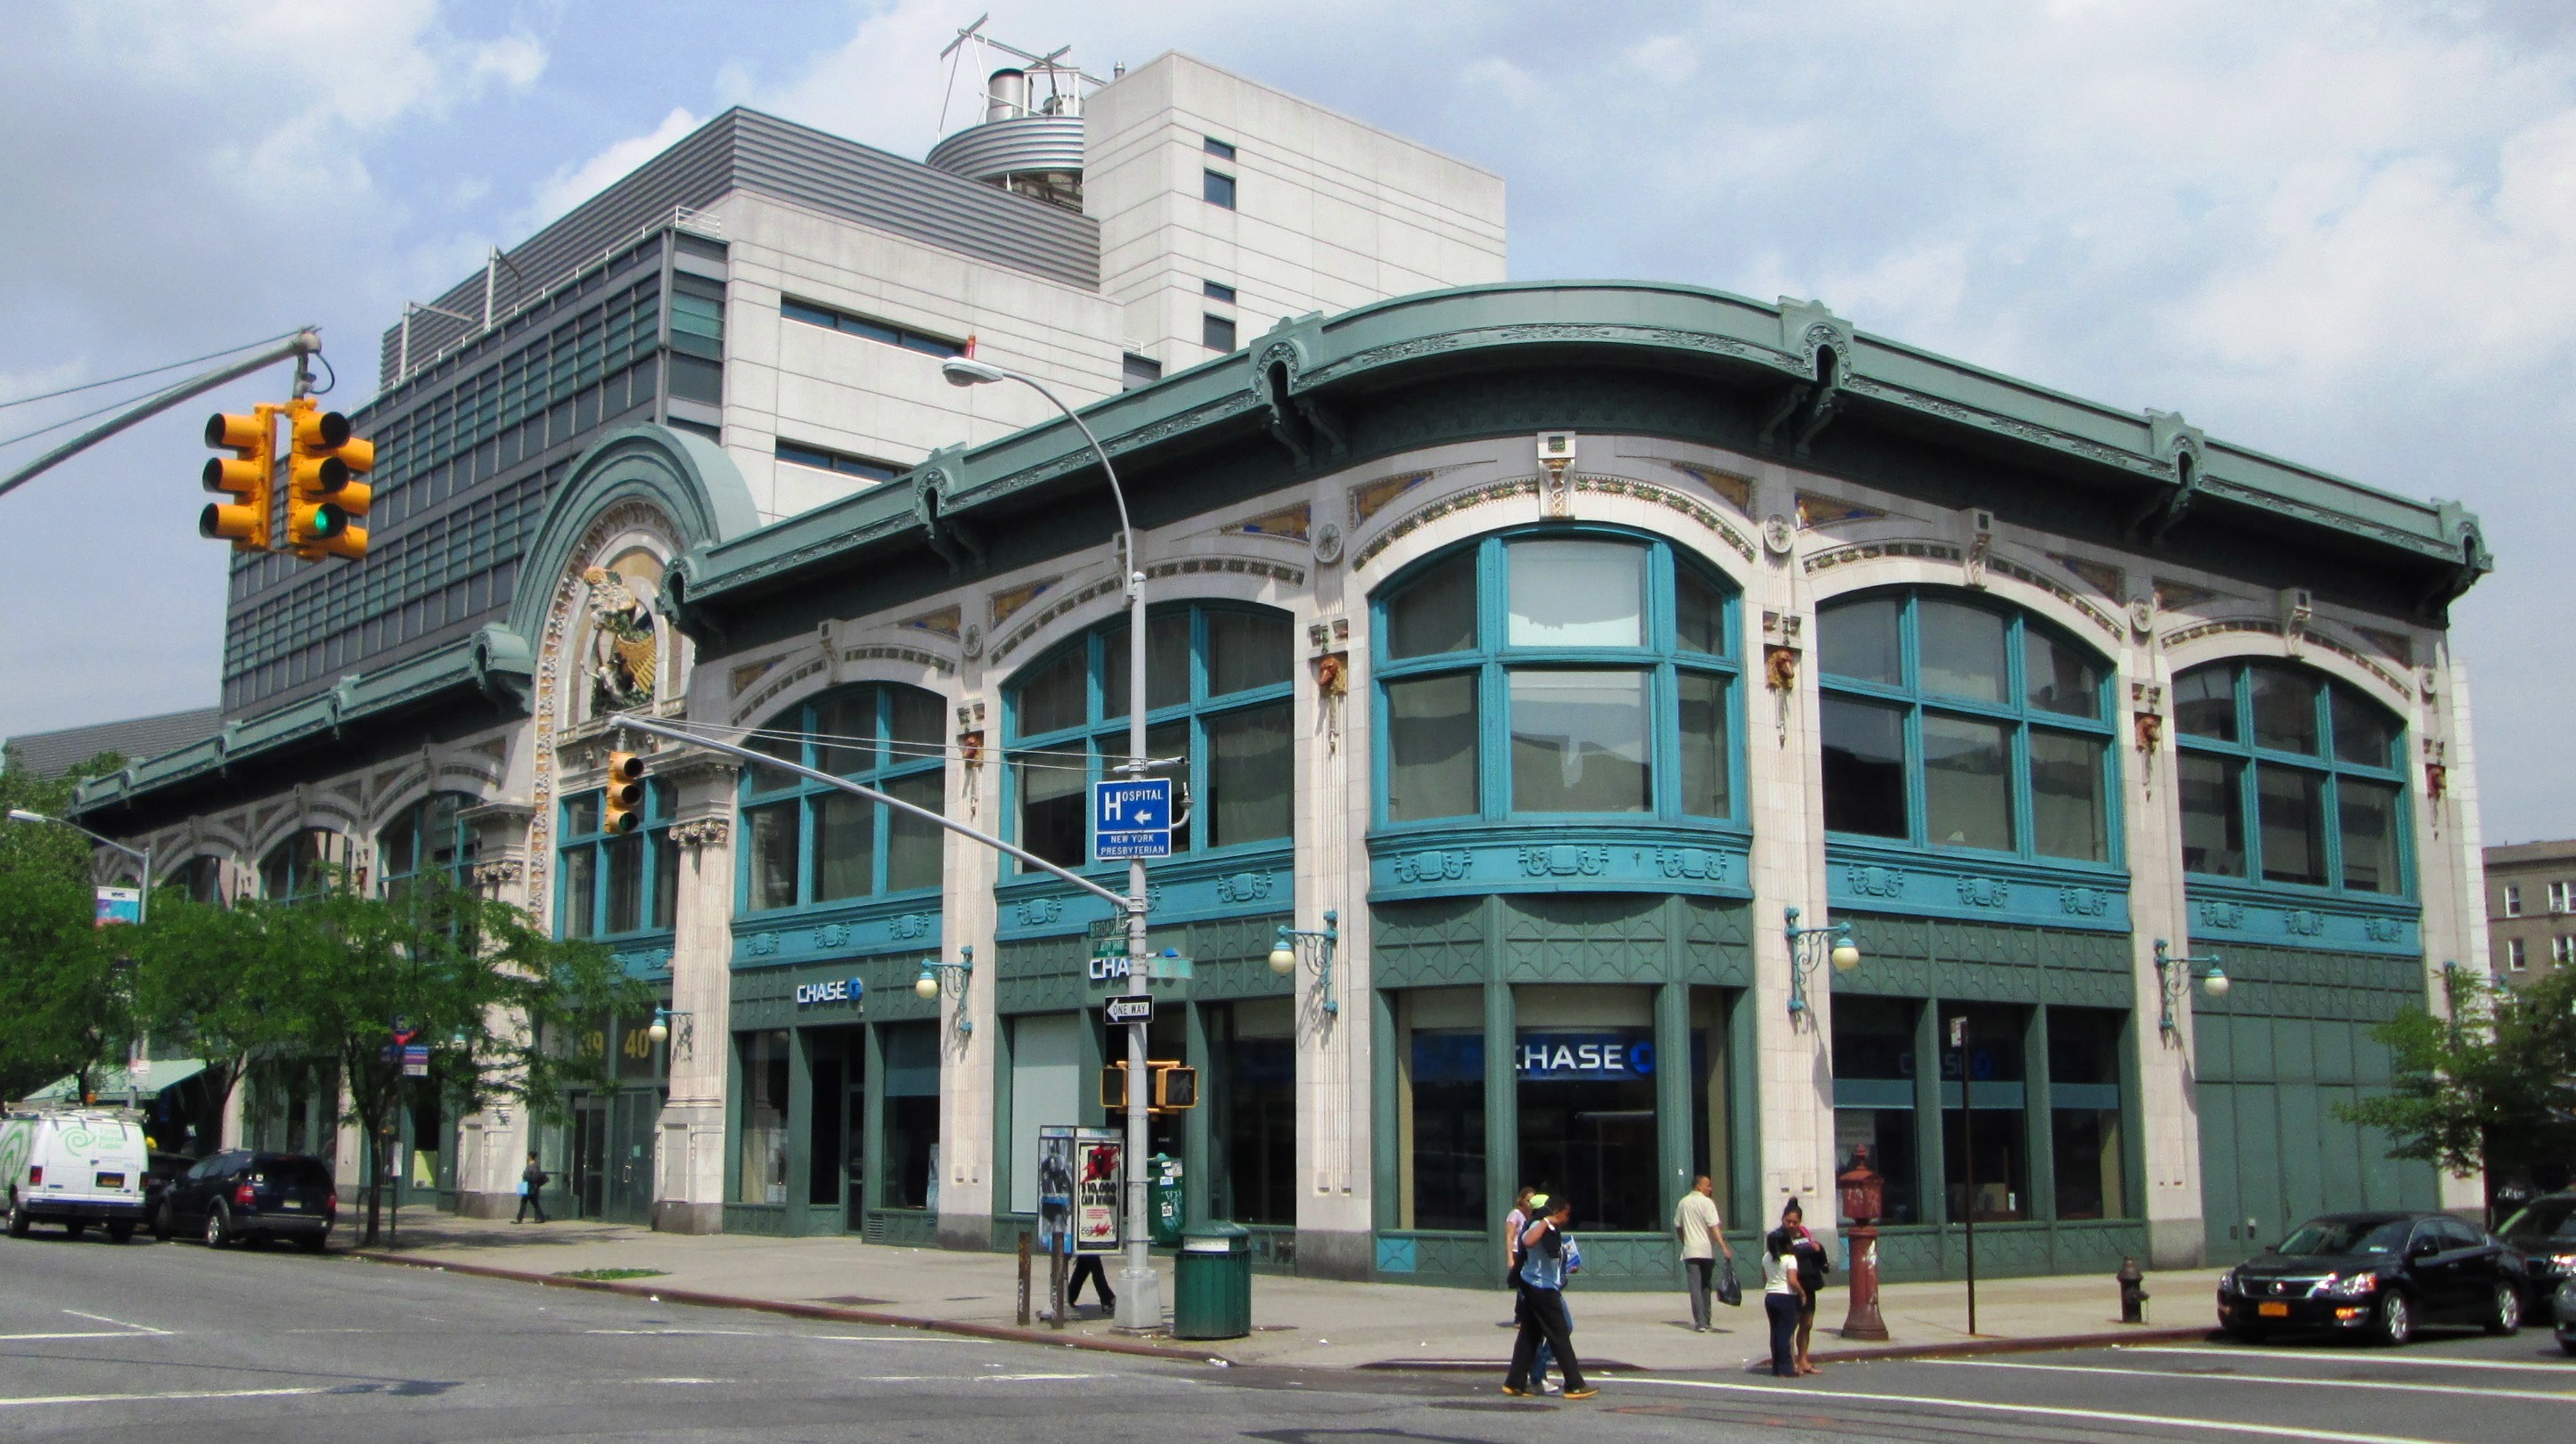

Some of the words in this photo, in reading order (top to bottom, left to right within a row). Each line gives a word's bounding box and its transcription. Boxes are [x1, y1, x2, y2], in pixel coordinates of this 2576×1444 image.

[1105, 789, 1164, 820] HOSPITAL
[1110, 835, 1129, 844] NEW
[1131, 834, 1154, 843] YORK
[1100, 845, 1165, 855] PRESBYTERIAN
[797, 981, 848, 1004] CHASE
[1113, 1005, 1127, 1016] ONE
[1131, 1003, 1146, 1014] WAY
[625, 1028, 650, 1058] 40
